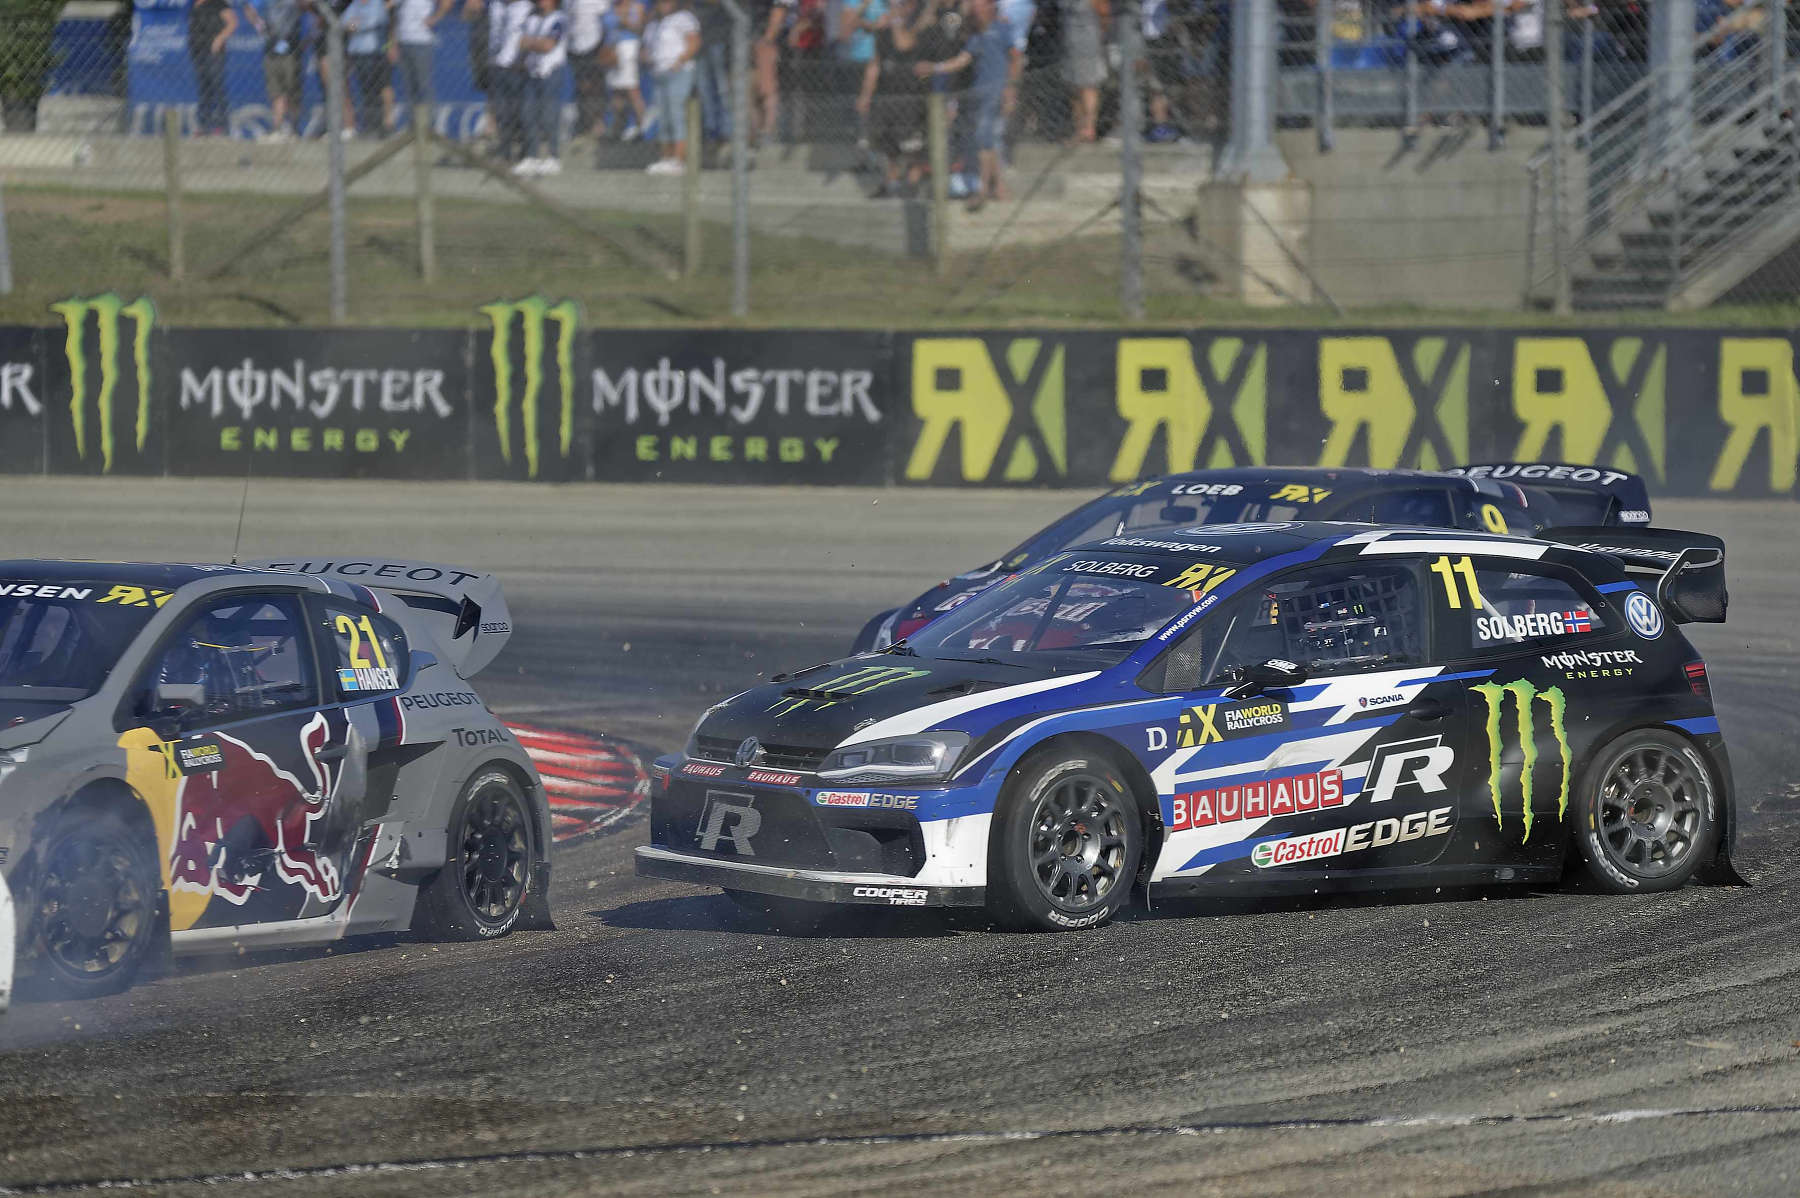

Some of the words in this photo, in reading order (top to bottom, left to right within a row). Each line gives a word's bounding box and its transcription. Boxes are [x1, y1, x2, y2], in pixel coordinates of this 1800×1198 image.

[180, 357, 453, 419] MONSTER
[591, 357, 884, 424] MONSTER
[904, 337, 1070, 482] RX
[1110, 336, 1268, 482] RX
[219, 427, 412, 452] ENERGY
[635, 434, 841, 462] ENERGY
[1171, 483, 1244, 496] LOEB
[1062, 560, 1161, 579] SOLBERG
[1431, 555, 1483, 610] 11
[1476, 612, 1564, 641] SOLBERG
[335, 614, 388, 669] 21
[1541, 649, 1645, 670] MONSTER
[355, 667, 399, 691] HANSEN
[1566, 668, 1634, 680] ENERGY
[400, 692, 481, 711] PEUGEOT
[1369, 692, 1405, 707] SCANIA
[1226, 713, 1284, 731] RALLYCROSS
[683, 764, 725, 776] BAUHAUS
[748, 772, 800, 785] BAUHAUS
[1363, 734, 1455, 803] R
[828, 793, 867, 805] Castrol
[869, 793, 921, 809] EDGE
[1174, 773, 1341, 825] BAUHAUS
[696, 789, 762, 857] R
[1273, 832, 1342, 864] Castrol
[1343, 806, 1454, 852] EDGE
[853, 887, 929, 899] COOPER
[889, 897, 927, 906] TIRES
